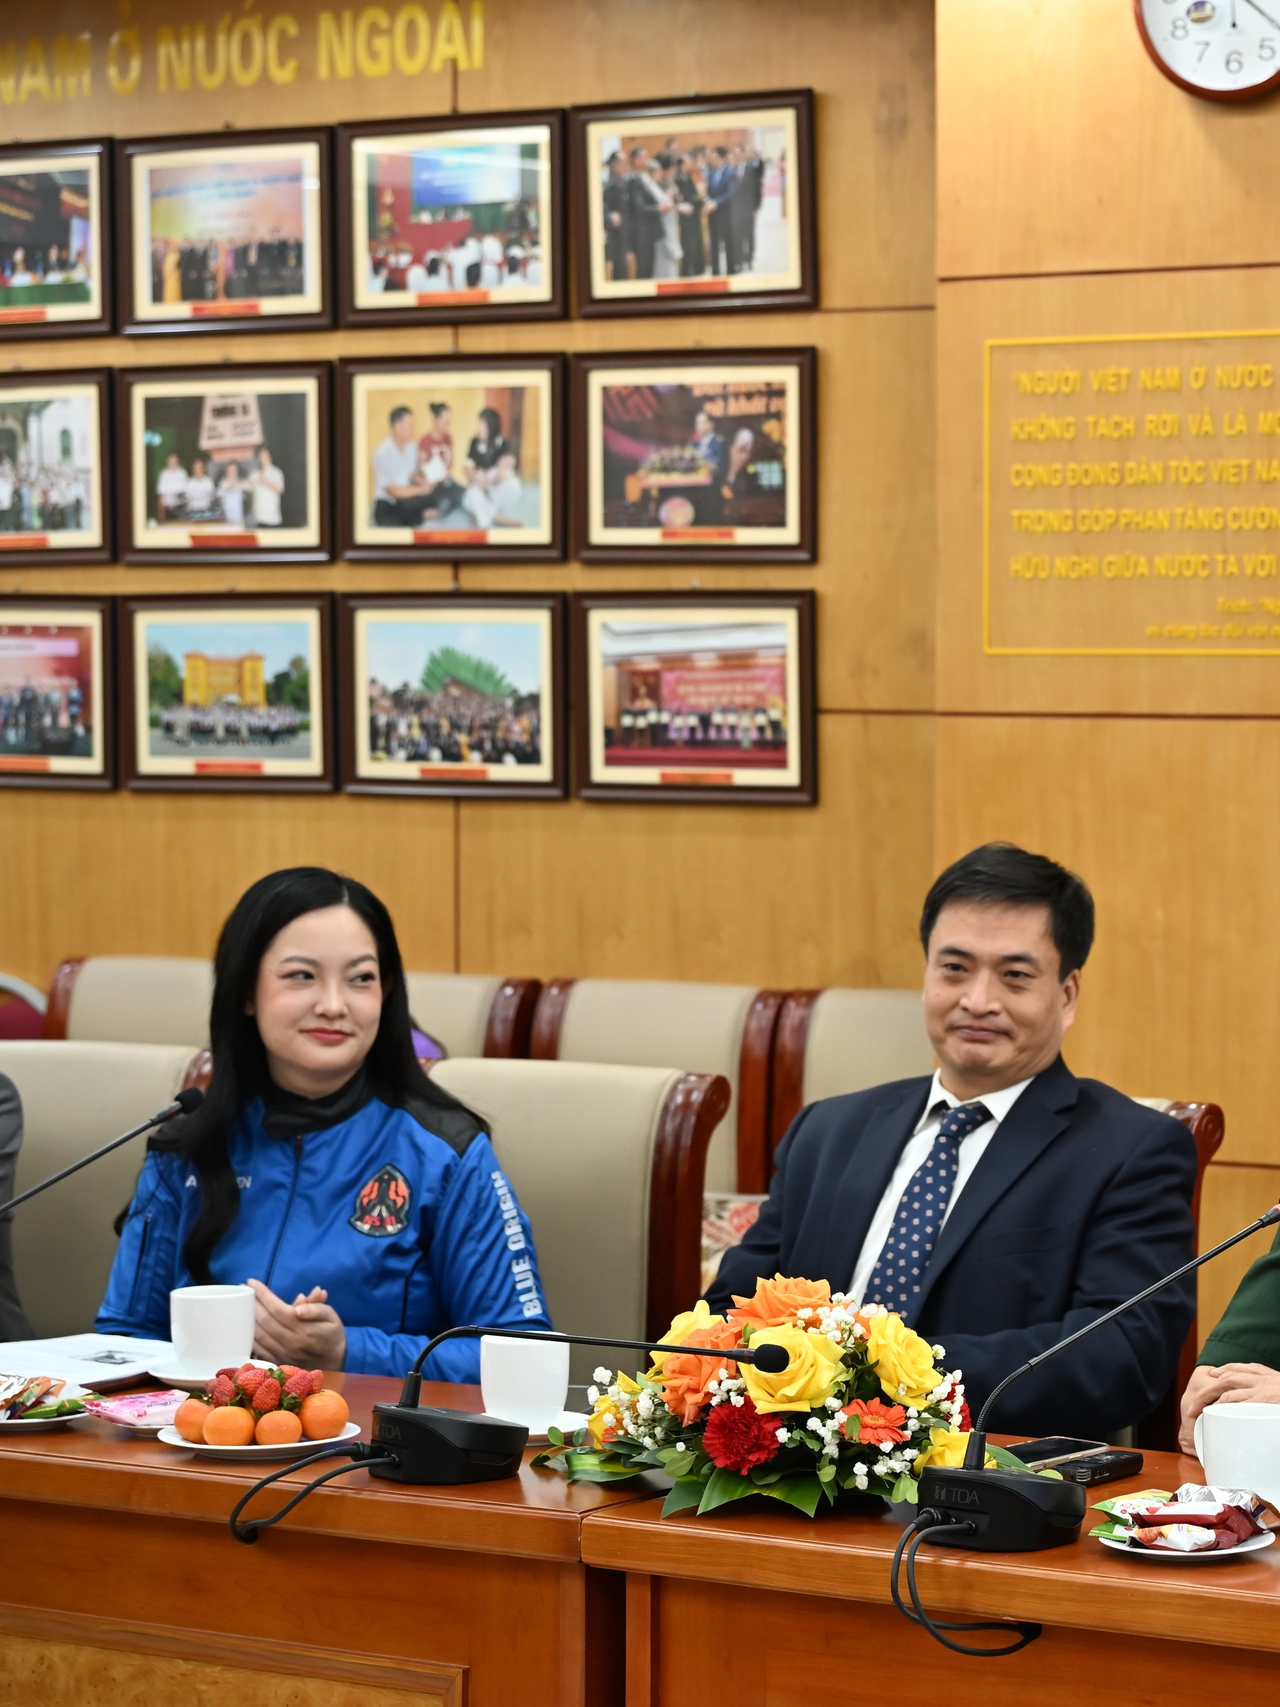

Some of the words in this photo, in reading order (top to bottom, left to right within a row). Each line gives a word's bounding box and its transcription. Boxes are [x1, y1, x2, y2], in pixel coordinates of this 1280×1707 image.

[1170, 17, 1189, 41] 8
[1194, 41, 1210, 64] 7
[1258, 37, 1276, 62] 5
[1225, 50, 1243, 75] 6
[1139, 367, 1182, 390] NAM
[1214, 554, 1239, 576] TA
[491, 1170, 526, 1251] ORIGIN
[511, 1254, 543, 1318] BLUE
[950, 1487, 980, 1505] TOA
